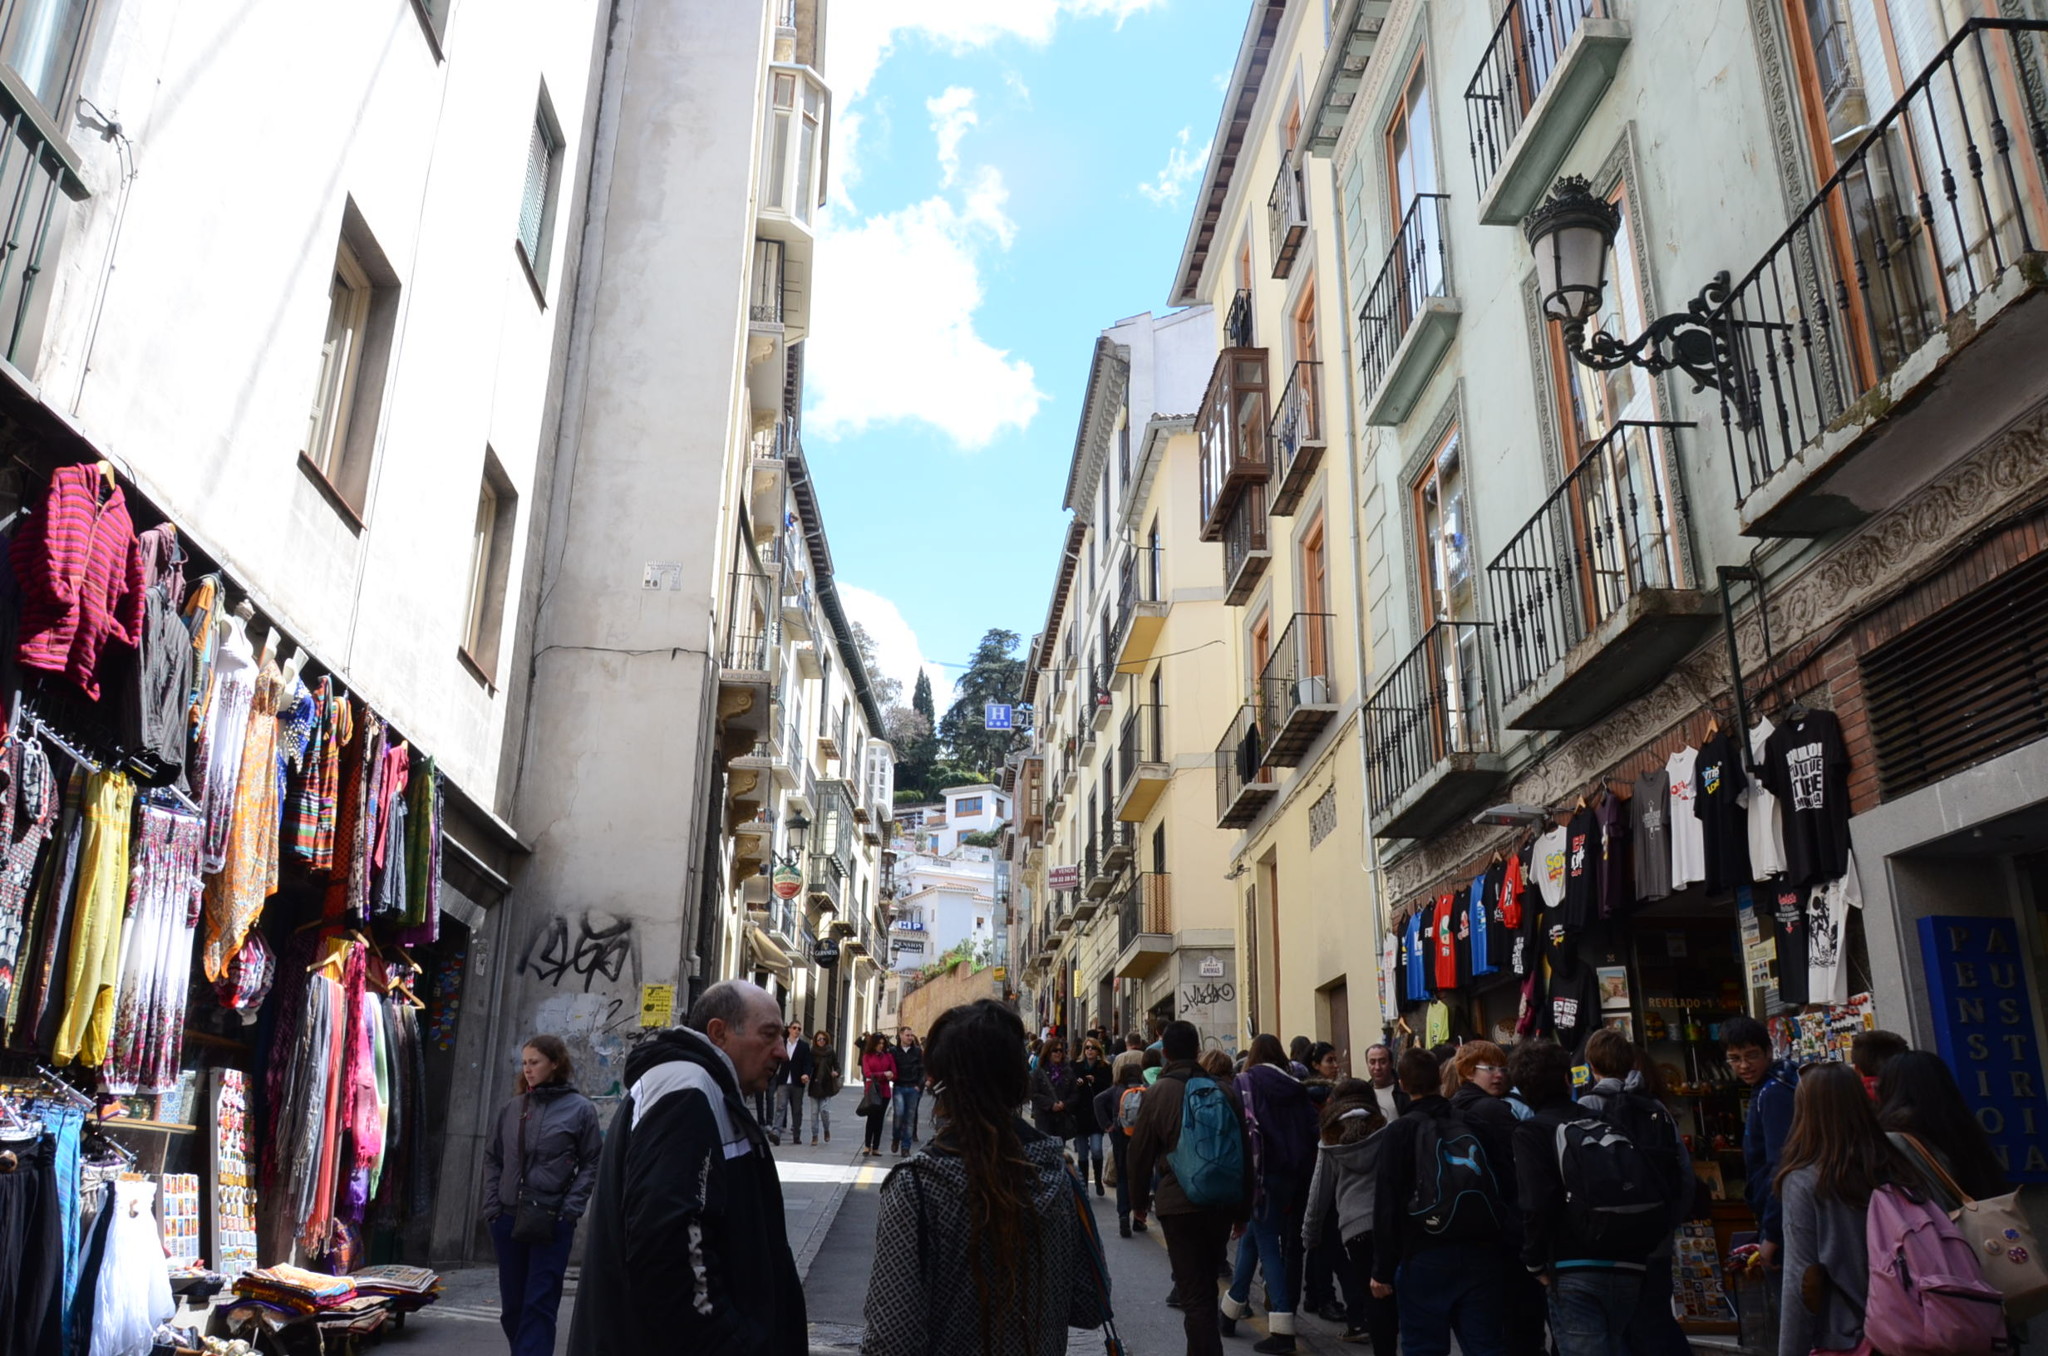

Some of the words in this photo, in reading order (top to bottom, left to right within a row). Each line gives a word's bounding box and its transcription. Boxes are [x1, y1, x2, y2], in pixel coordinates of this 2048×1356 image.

[991, 707, 1006, 721] H
[913, 922, 921, 930] P
[1648, 997, 1701, 1008] REVELADO
[1985, 926, 2048, 1173] AUSTRIA
